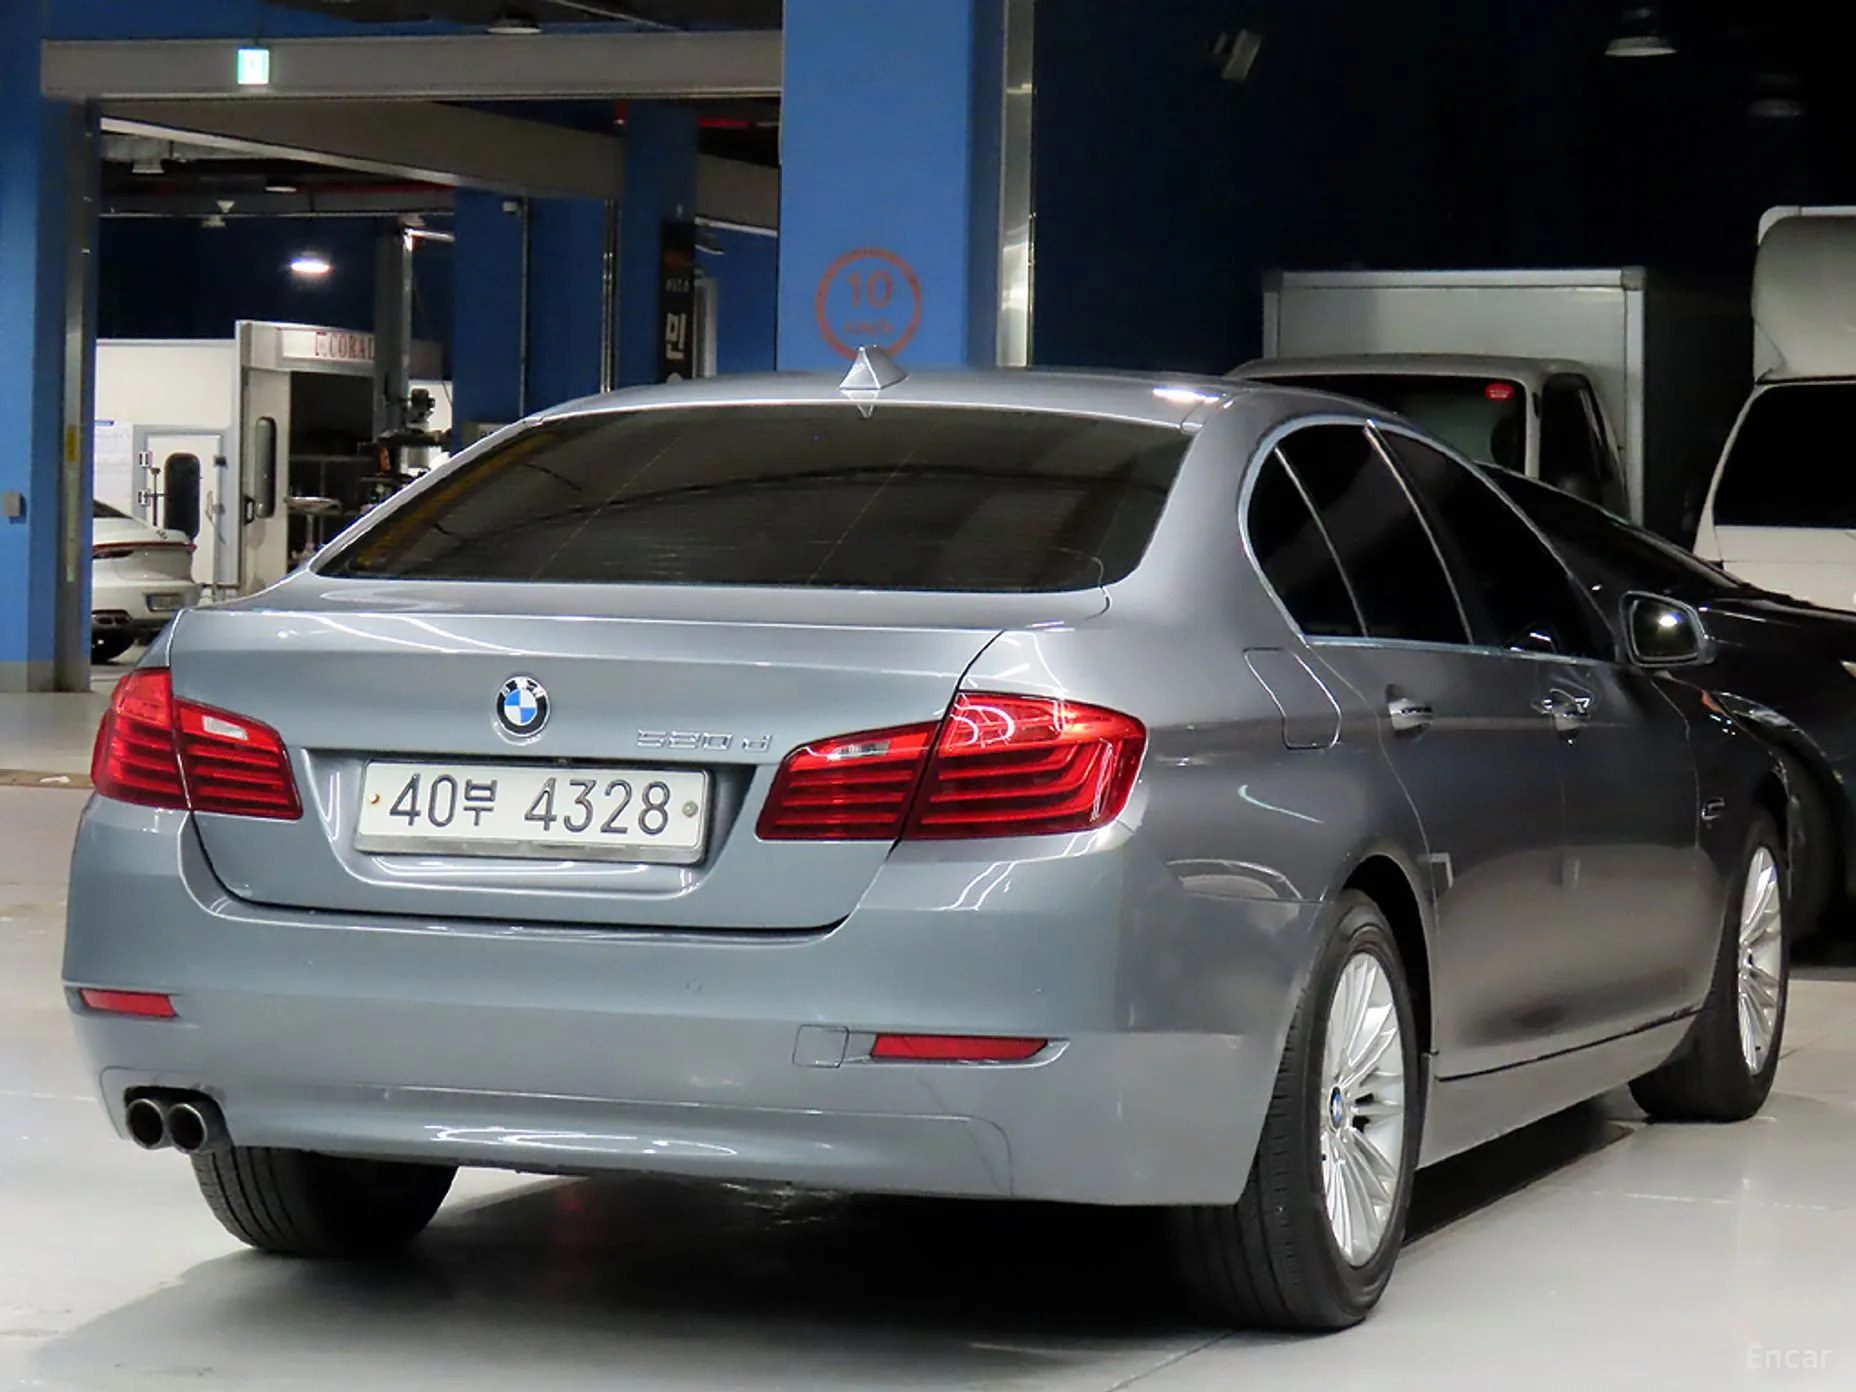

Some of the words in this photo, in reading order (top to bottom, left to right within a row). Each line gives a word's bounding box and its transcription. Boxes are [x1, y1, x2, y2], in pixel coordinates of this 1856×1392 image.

[848, 270, 892, 308] 10
[637, 729, 733, 750] 520
[742, 734, 772, 752] d
[389, 773, 498, 828] 40부
[524, 777, 671, 836] 4328
